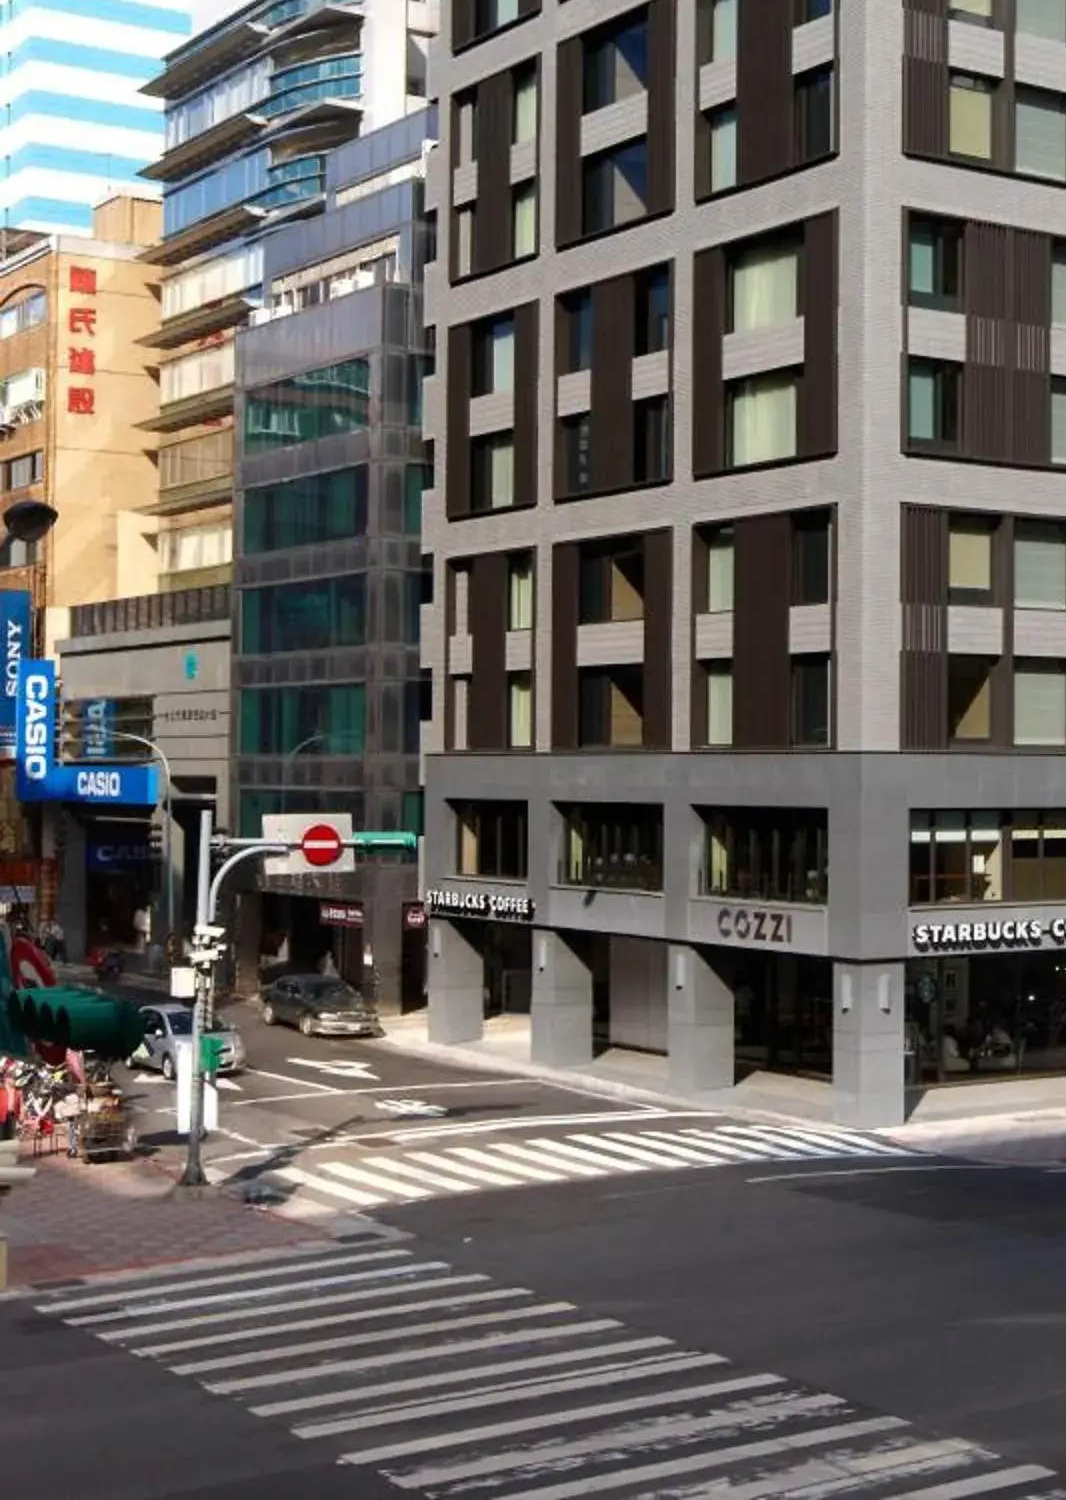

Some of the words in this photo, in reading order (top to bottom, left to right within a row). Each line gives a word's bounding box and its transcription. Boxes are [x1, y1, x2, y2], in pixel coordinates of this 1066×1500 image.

[5, 620, 23, 697] SONY
[25, 675, 49, 780] CASIO
[77, 771, 121, 796] CASIO
[490, 895, 529, 913] COFFEE
[718, 907, 792, 944] COZZI
[914, 920, 1041, 944] STARBUCKS
